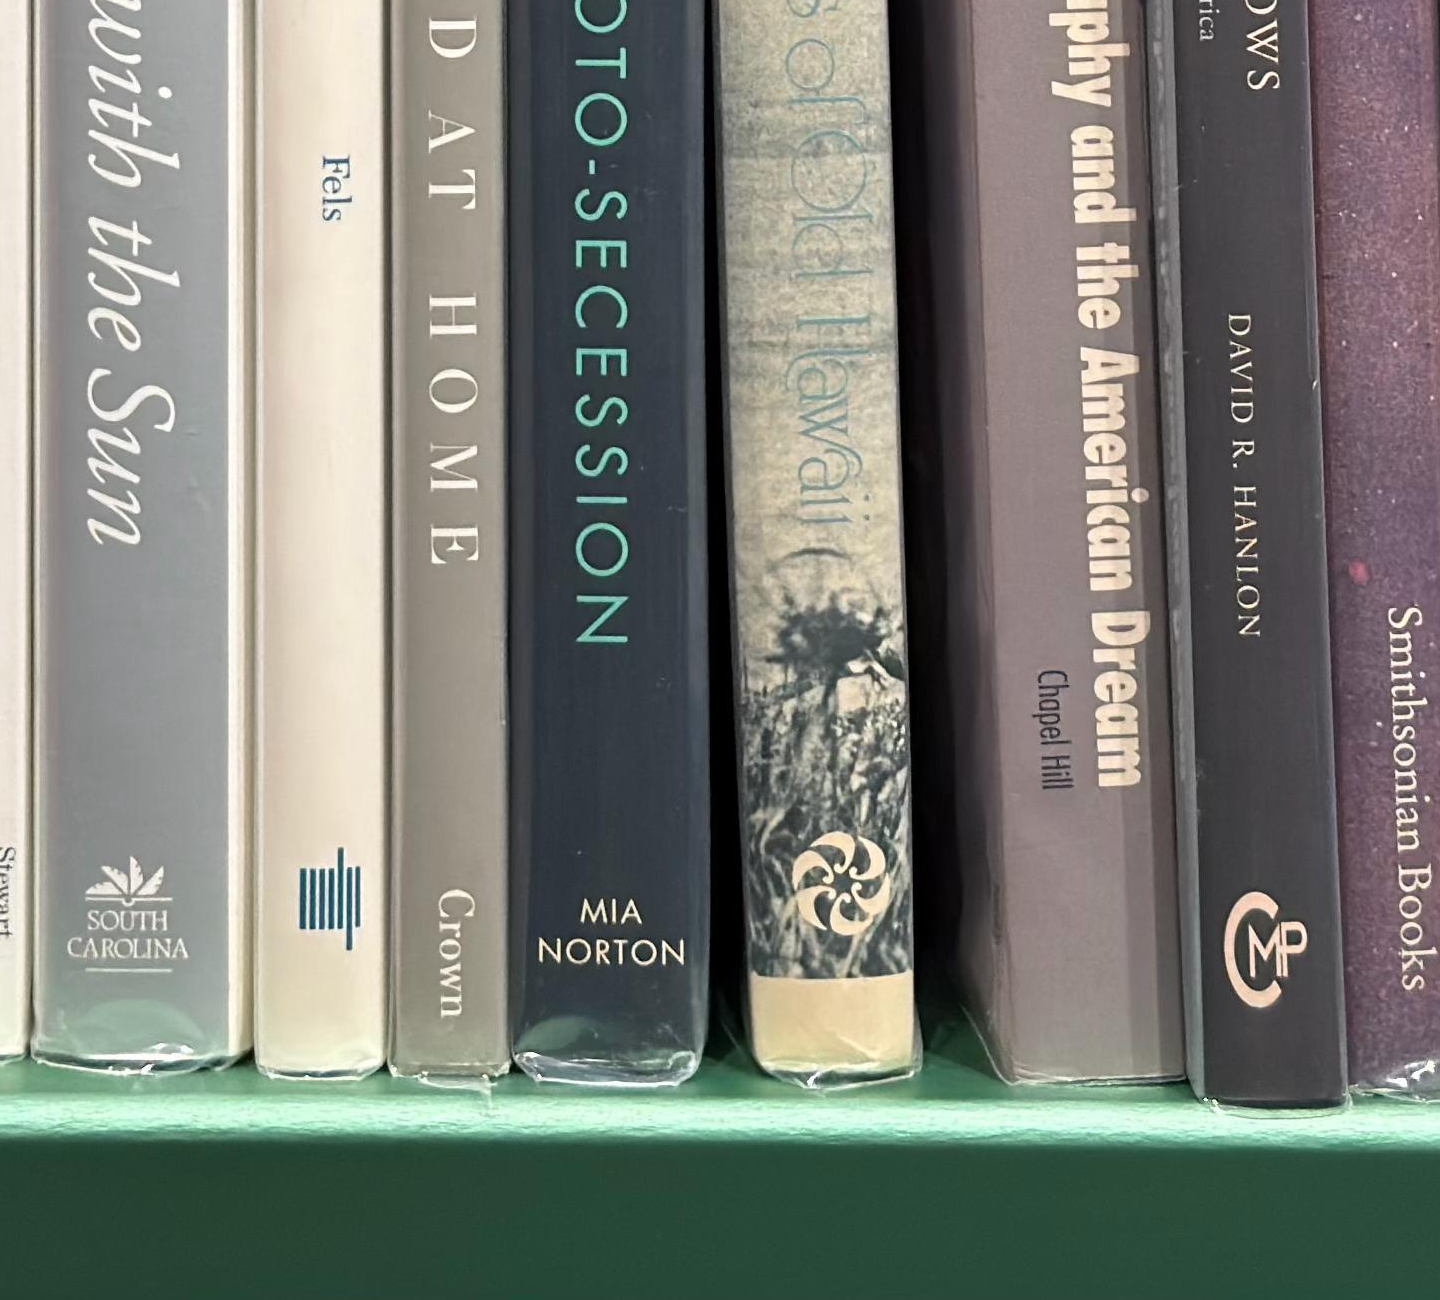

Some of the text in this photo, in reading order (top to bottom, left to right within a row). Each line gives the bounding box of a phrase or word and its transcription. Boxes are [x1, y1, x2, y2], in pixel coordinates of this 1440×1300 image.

[320, 155, 352, 222] Fels
[427, 110, 478, 210] AT
[1070, 126, 1137, 224] and
[86, 216, 180, 352] the
[1077, 243, 1140, 329] the
[86, 368, 176, 546] Sun
[428, 293, 480, 564] HOME
[1080, 347, 1149, 591] American
[1226, 313, 1262, 637] DAVID R. HANLON
[1033, 670, 1075, 789] Chapel Hill
[1090, 611, 1151, 787] Dream
[1387, 603, 1438, 991] Smithsonian Books
[67, 935, 189, 960] CAROLINA
[86, 909, 169, 932] SOUTH
[438, 888, 476, 1017] Crown
[538, 937, 685, 966] NORTON
[580, 898, 642, 923] MIA
